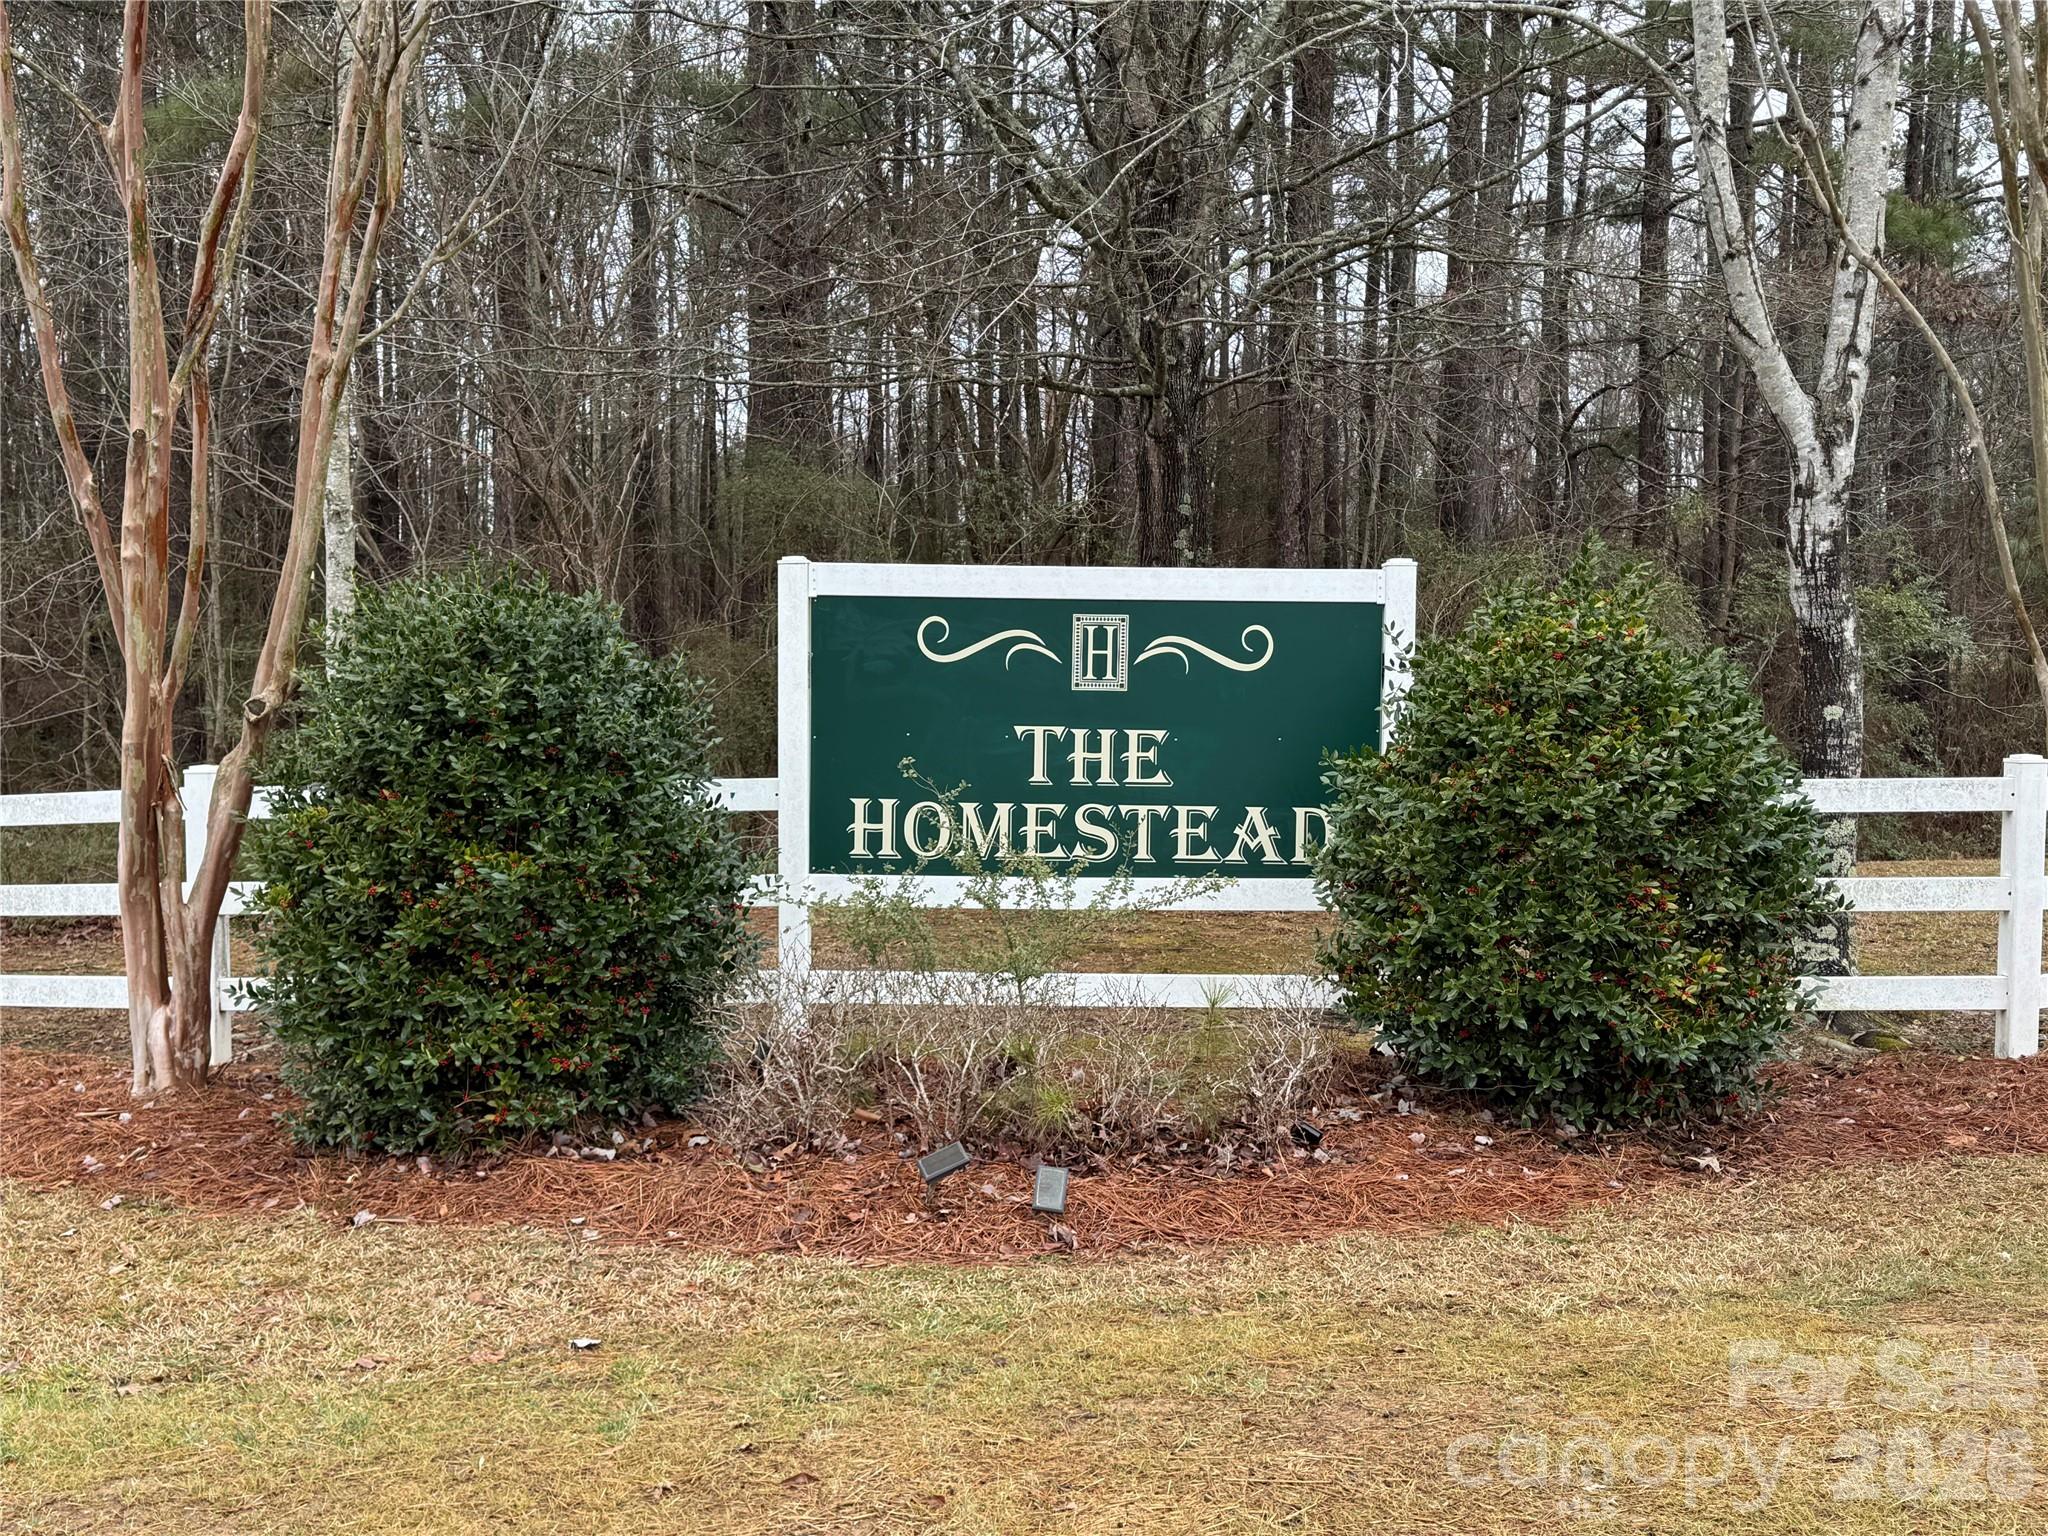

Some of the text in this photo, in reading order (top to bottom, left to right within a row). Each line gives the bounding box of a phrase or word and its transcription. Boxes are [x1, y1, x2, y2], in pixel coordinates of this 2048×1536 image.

[1082, 625, 1118, 680] H
[1013, 725, 1174, 787] THE
[847, 797, 1333, 866] HOMESTEAD
